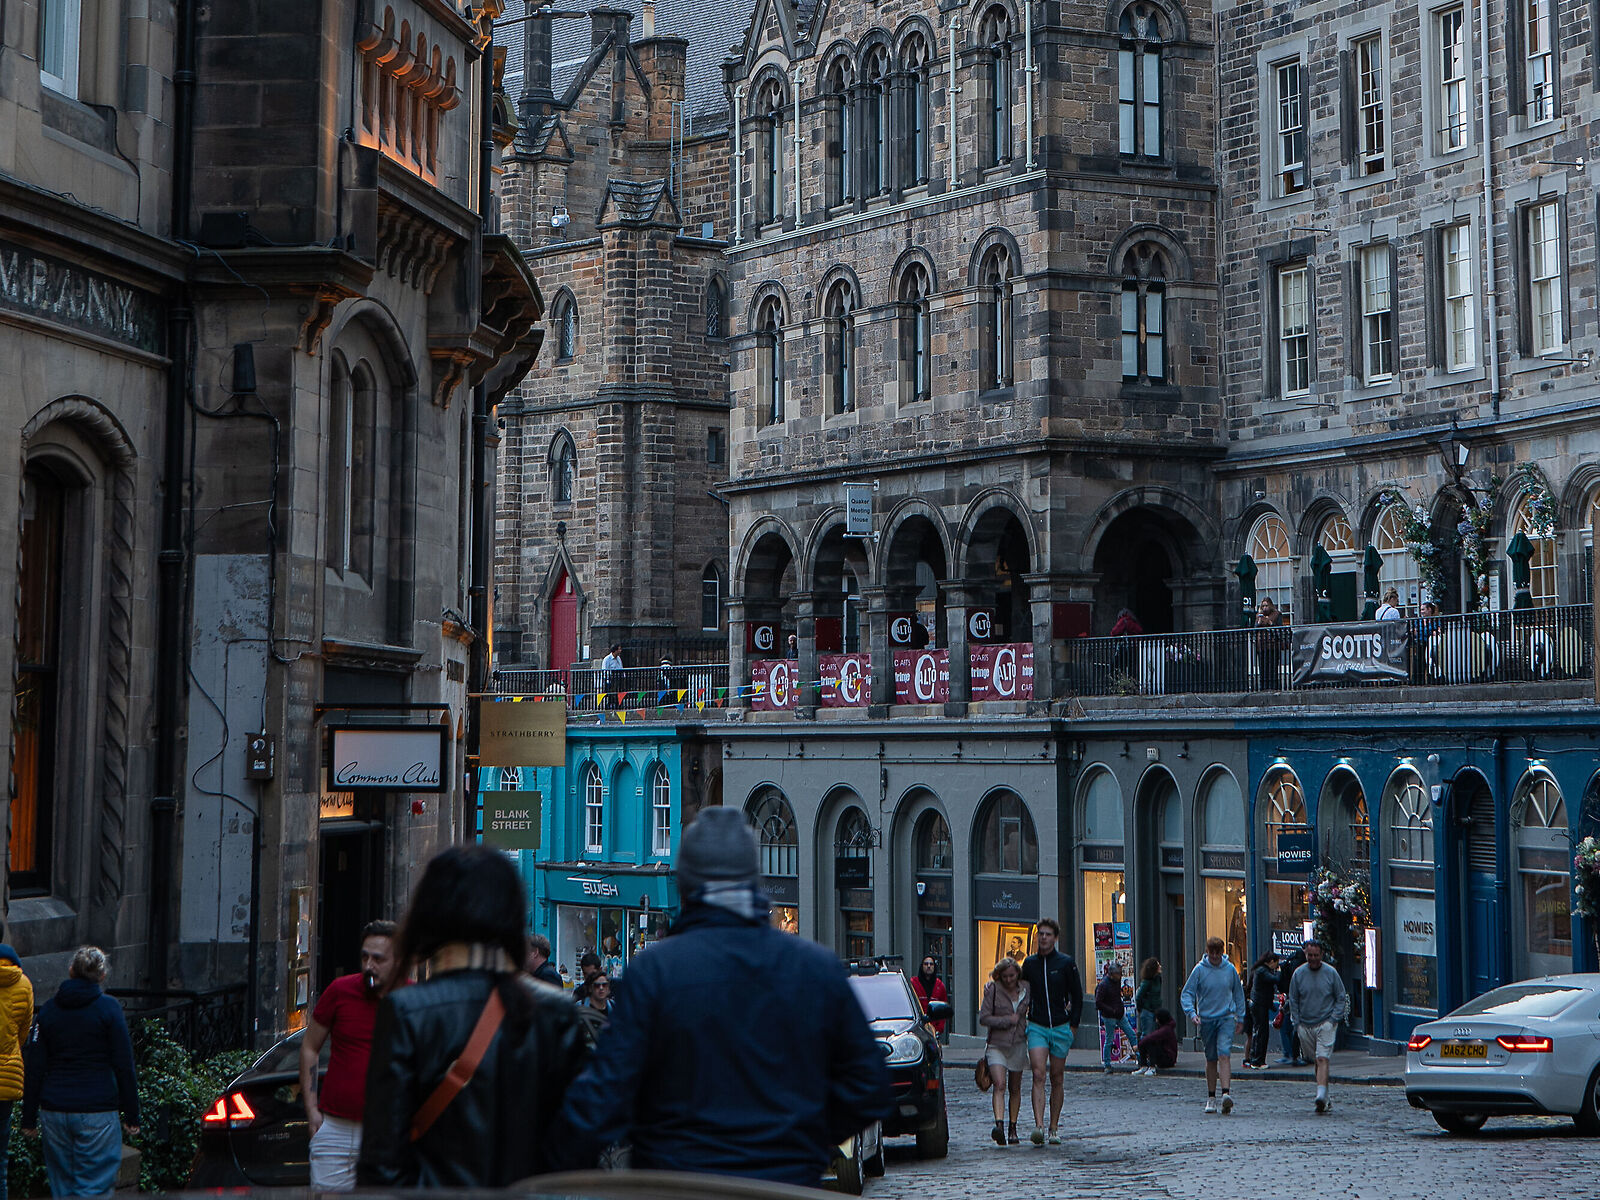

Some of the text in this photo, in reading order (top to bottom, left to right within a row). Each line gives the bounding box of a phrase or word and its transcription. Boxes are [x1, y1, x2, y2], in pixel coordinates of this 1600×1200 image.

[851, 507, 871, 515] Meeting
[1321, 633, 1382, 660] SCOTTS
[895, 671, 910, 683] fringe
[970, 667, 990, 680] fringe
[337, 761, 439, 784] Commons Club
[495, 809, 530, 819] BLANK
[491, 821, 532, 830] STREET
[1096, 849, 1114, 861] TWEED
[1279, 850, 1312, 859] HOWIES
[582, 882, 619, 896] SWISH
[1536, 900, 1567, 914] HOWIES
[1403, 920, 1434, 936] HOWIES
[1281, 931, 1299, 945] LOOK
